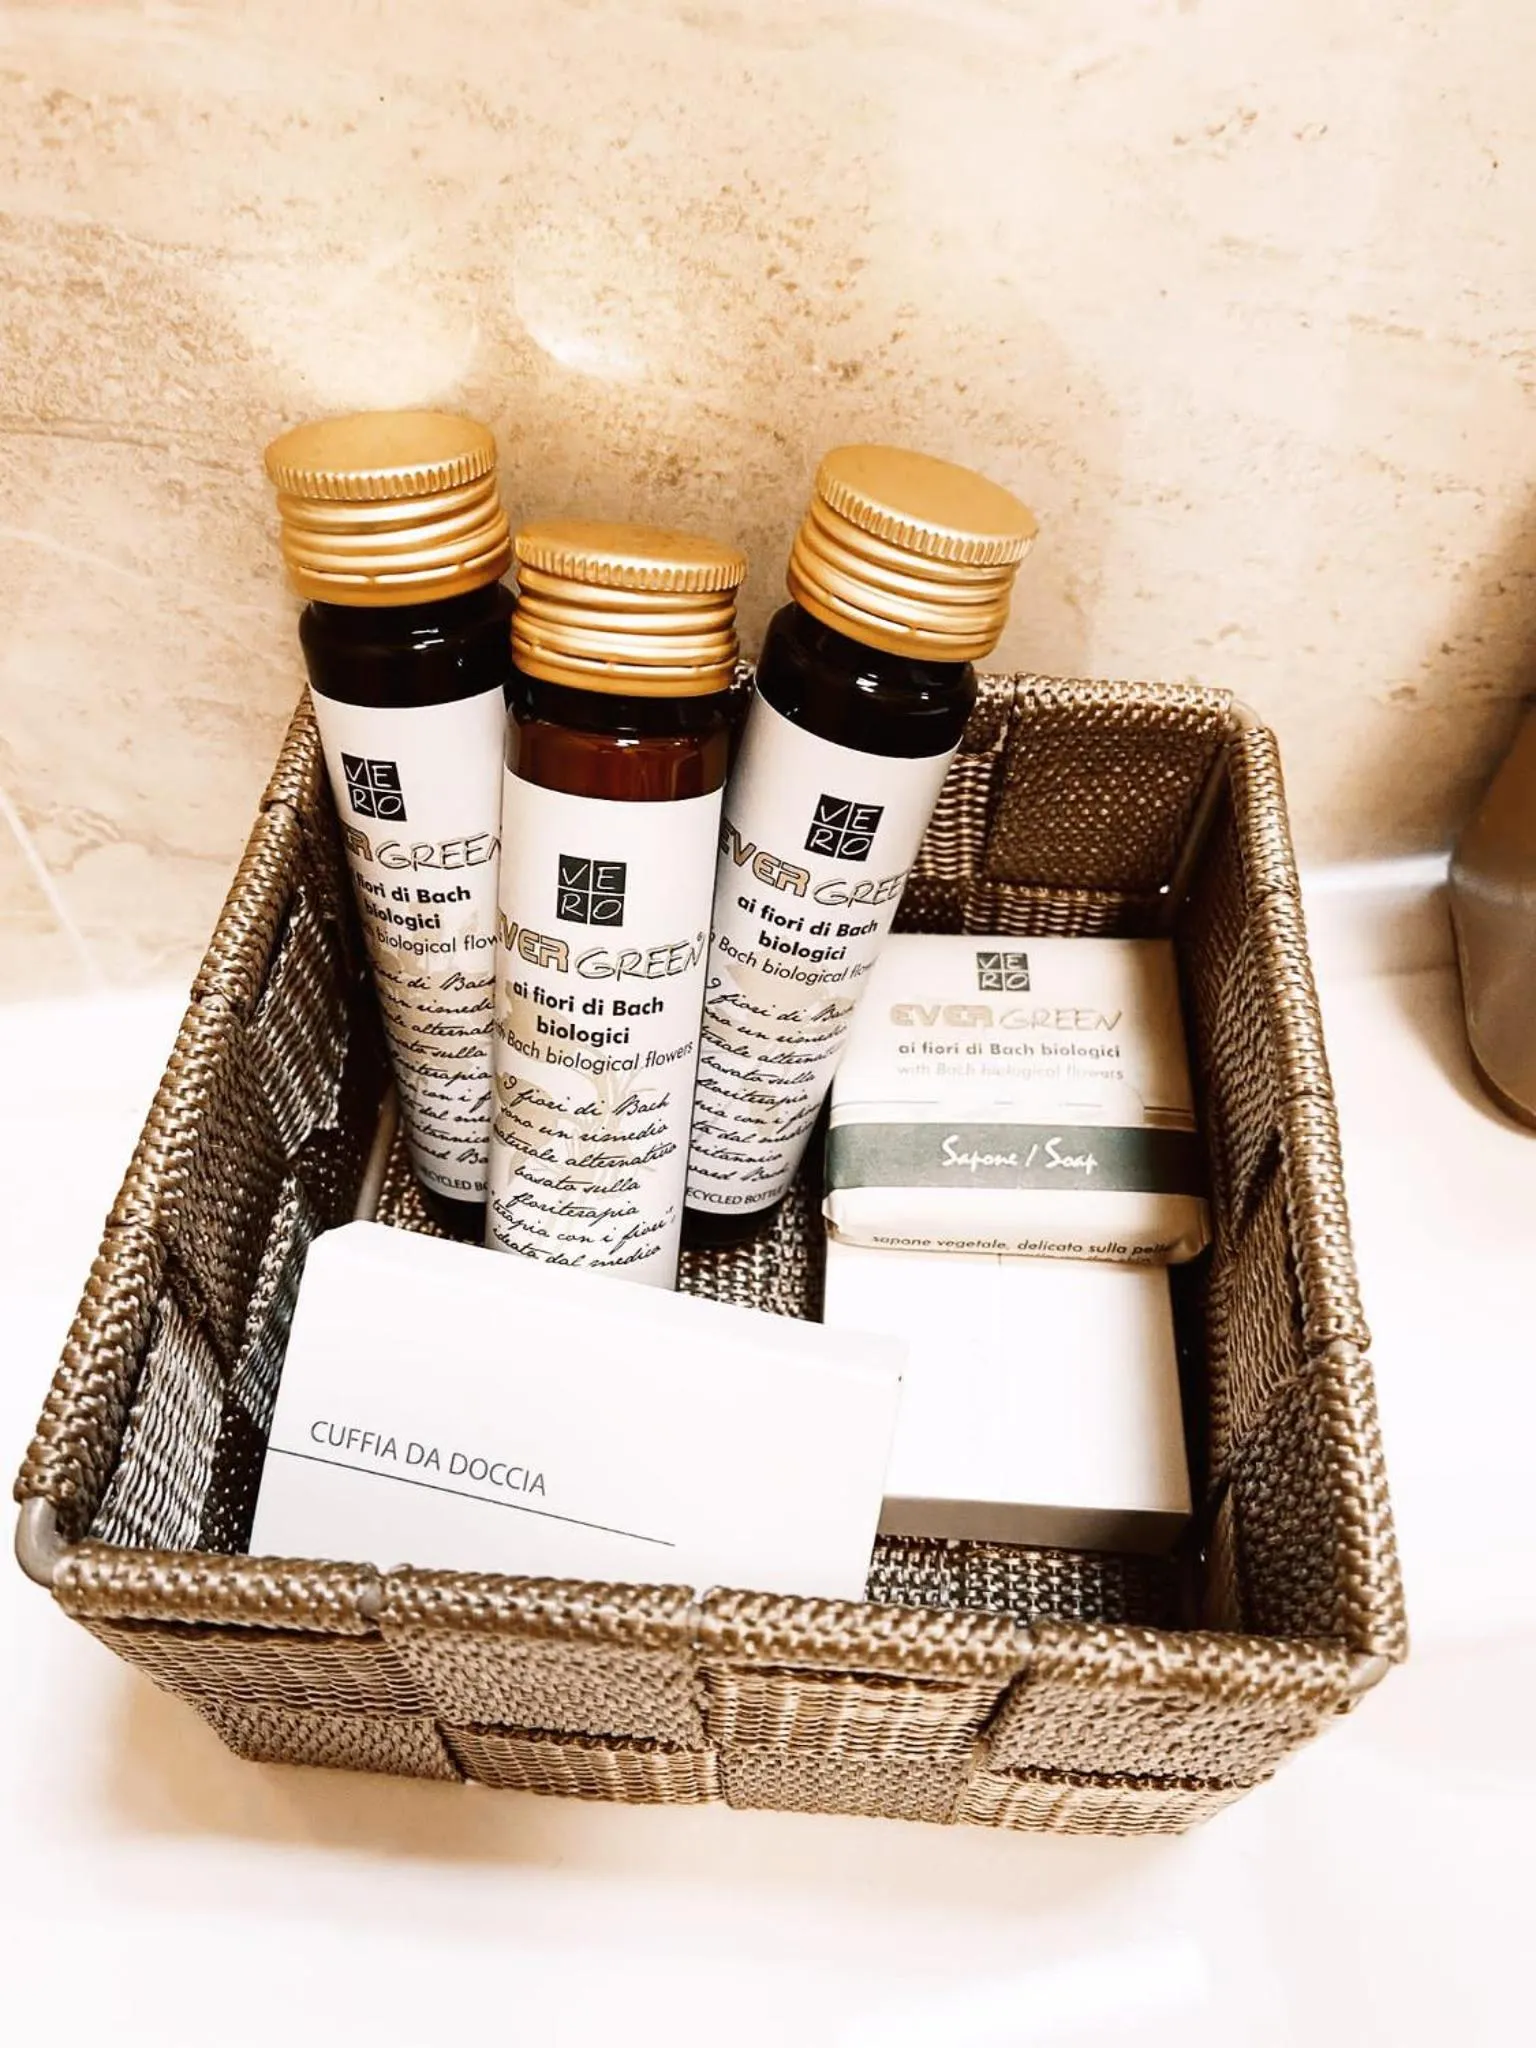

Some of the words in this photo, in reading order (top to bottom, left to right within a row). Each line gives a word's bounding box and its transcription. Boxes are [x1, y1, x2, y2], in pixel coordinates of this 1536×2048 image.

[391, 886, 410, 903] di
[416, 886, 471, 904] Bach
[363, 898, 441, 931] biologici
[737, 895, 757, 914] ai
[760, 904, 805, 933] fiori
[809, 921, 831, 937] di
[836, 919, 878, 937] Bach
[376, 926, 456, 956] biological
[464, 935, 498, 950] flow
[498, 909, 569, 973] VER
[758, 929, 848, 963] biologici
[718, 936, 758, 968] Bach
[761, 957, 847, 987] biological
[512, 980, 528, 998] ai
[533, 985, 575, 1012] fiori
[582, 998, 604, 1016] di
[612, 996, 664, 1017] Bach
[536, 1014, 630, 1048] biologici
[890, 1004, 993, 1027] EVER
[999, 1009, 1123, 1031] GREEN
[431, 1046, 488, 1059] sulla
[507, 1032, 541, 1058] Bach
[545, 1045, 640, 1075] biological
[645, 1041, 694, 1068] flowers
[898, 1042, 916, 1054] ai
[922, 1042, 959, 1054] fiori
[966, 1042, 983, 1055] di
[990, 1043, 1034, 1056] Bach
[1041, 1043, 1121, 1060] biologici
[511, 1089, 568, 1112] fiori
[573, 1100, 606, 1116] di
[612, 1091, 671, 1116] Bach
[538, 1125, 574, 1140] un
[564, 1142, 678, 1169] alternativo
[940, 1135, 1018, 1172] Sapone
[1044, 1136, 1099, 1174] Soap
[514, 1165, 592, 1191] basato
[583, 1179, 641, 1193] sulla
[506, 1192, 641, 1228] floriterapia
[687, 1187, 740, 1205] ECYCLED
[556, 1232, 594, 1244] con
[872, 1235, 931, 1247] sapone
[1017, 1239, 1083, 1253] delicato
[1088, 1242, 1128, 1254] sulla
[545, 1253, 584, 1268] dal
[588, 1242, 662, 1268] medico
[310, 1420, 397, 1461] CUFFIA
[405, 1442, 441, 1472] DA
[449, 1452, 546, 1497] DOCCIA
